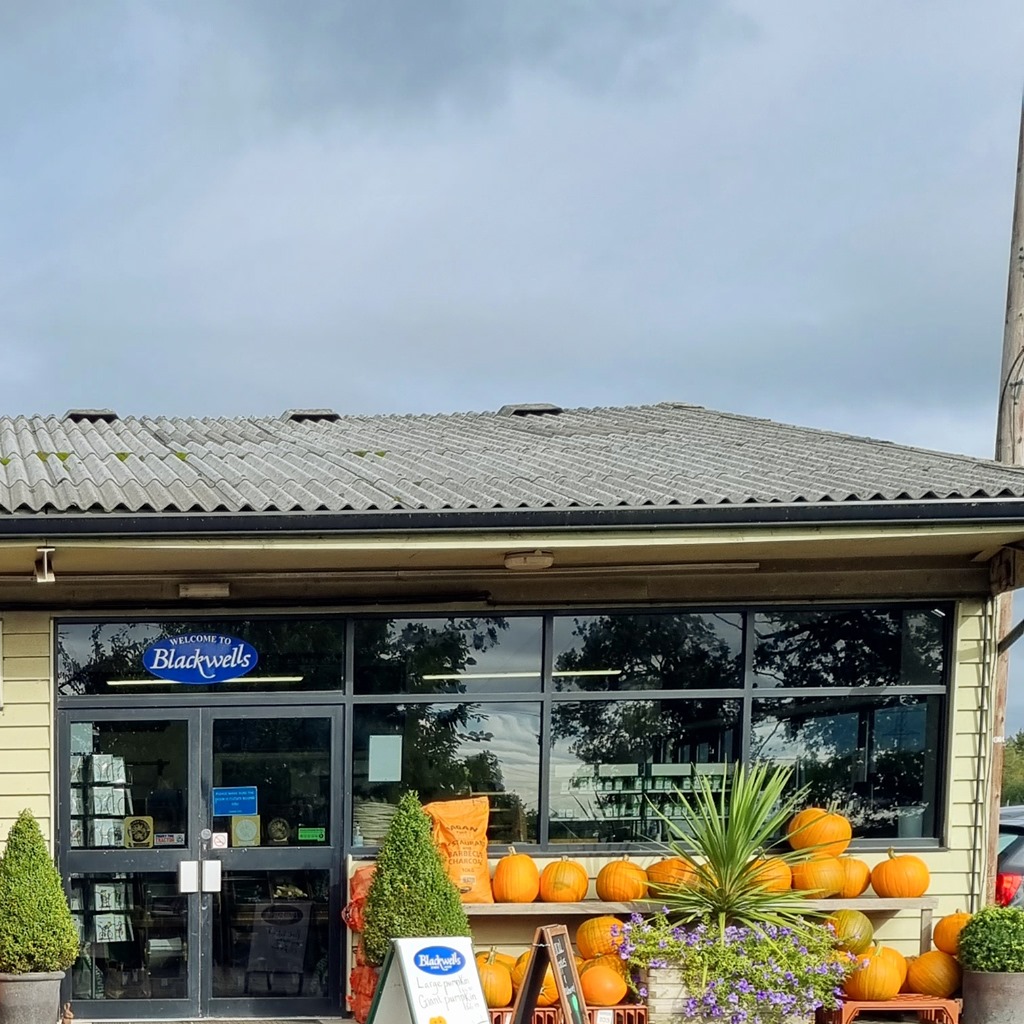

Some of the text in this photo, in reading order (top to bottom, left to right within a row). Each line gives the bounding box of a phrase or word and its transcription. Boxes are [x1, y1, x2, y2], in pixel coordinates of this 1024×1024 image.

[169, 635, 232, 646] WELCOME TO
[150, 643, 251, 679] Blackwells
[418, 951, 462, 971] Blackwells
[416, 976, 443, 996] Large
[418, 993, 442, 1009] Giant
[444, 992, 477, 1011] pumpkin
